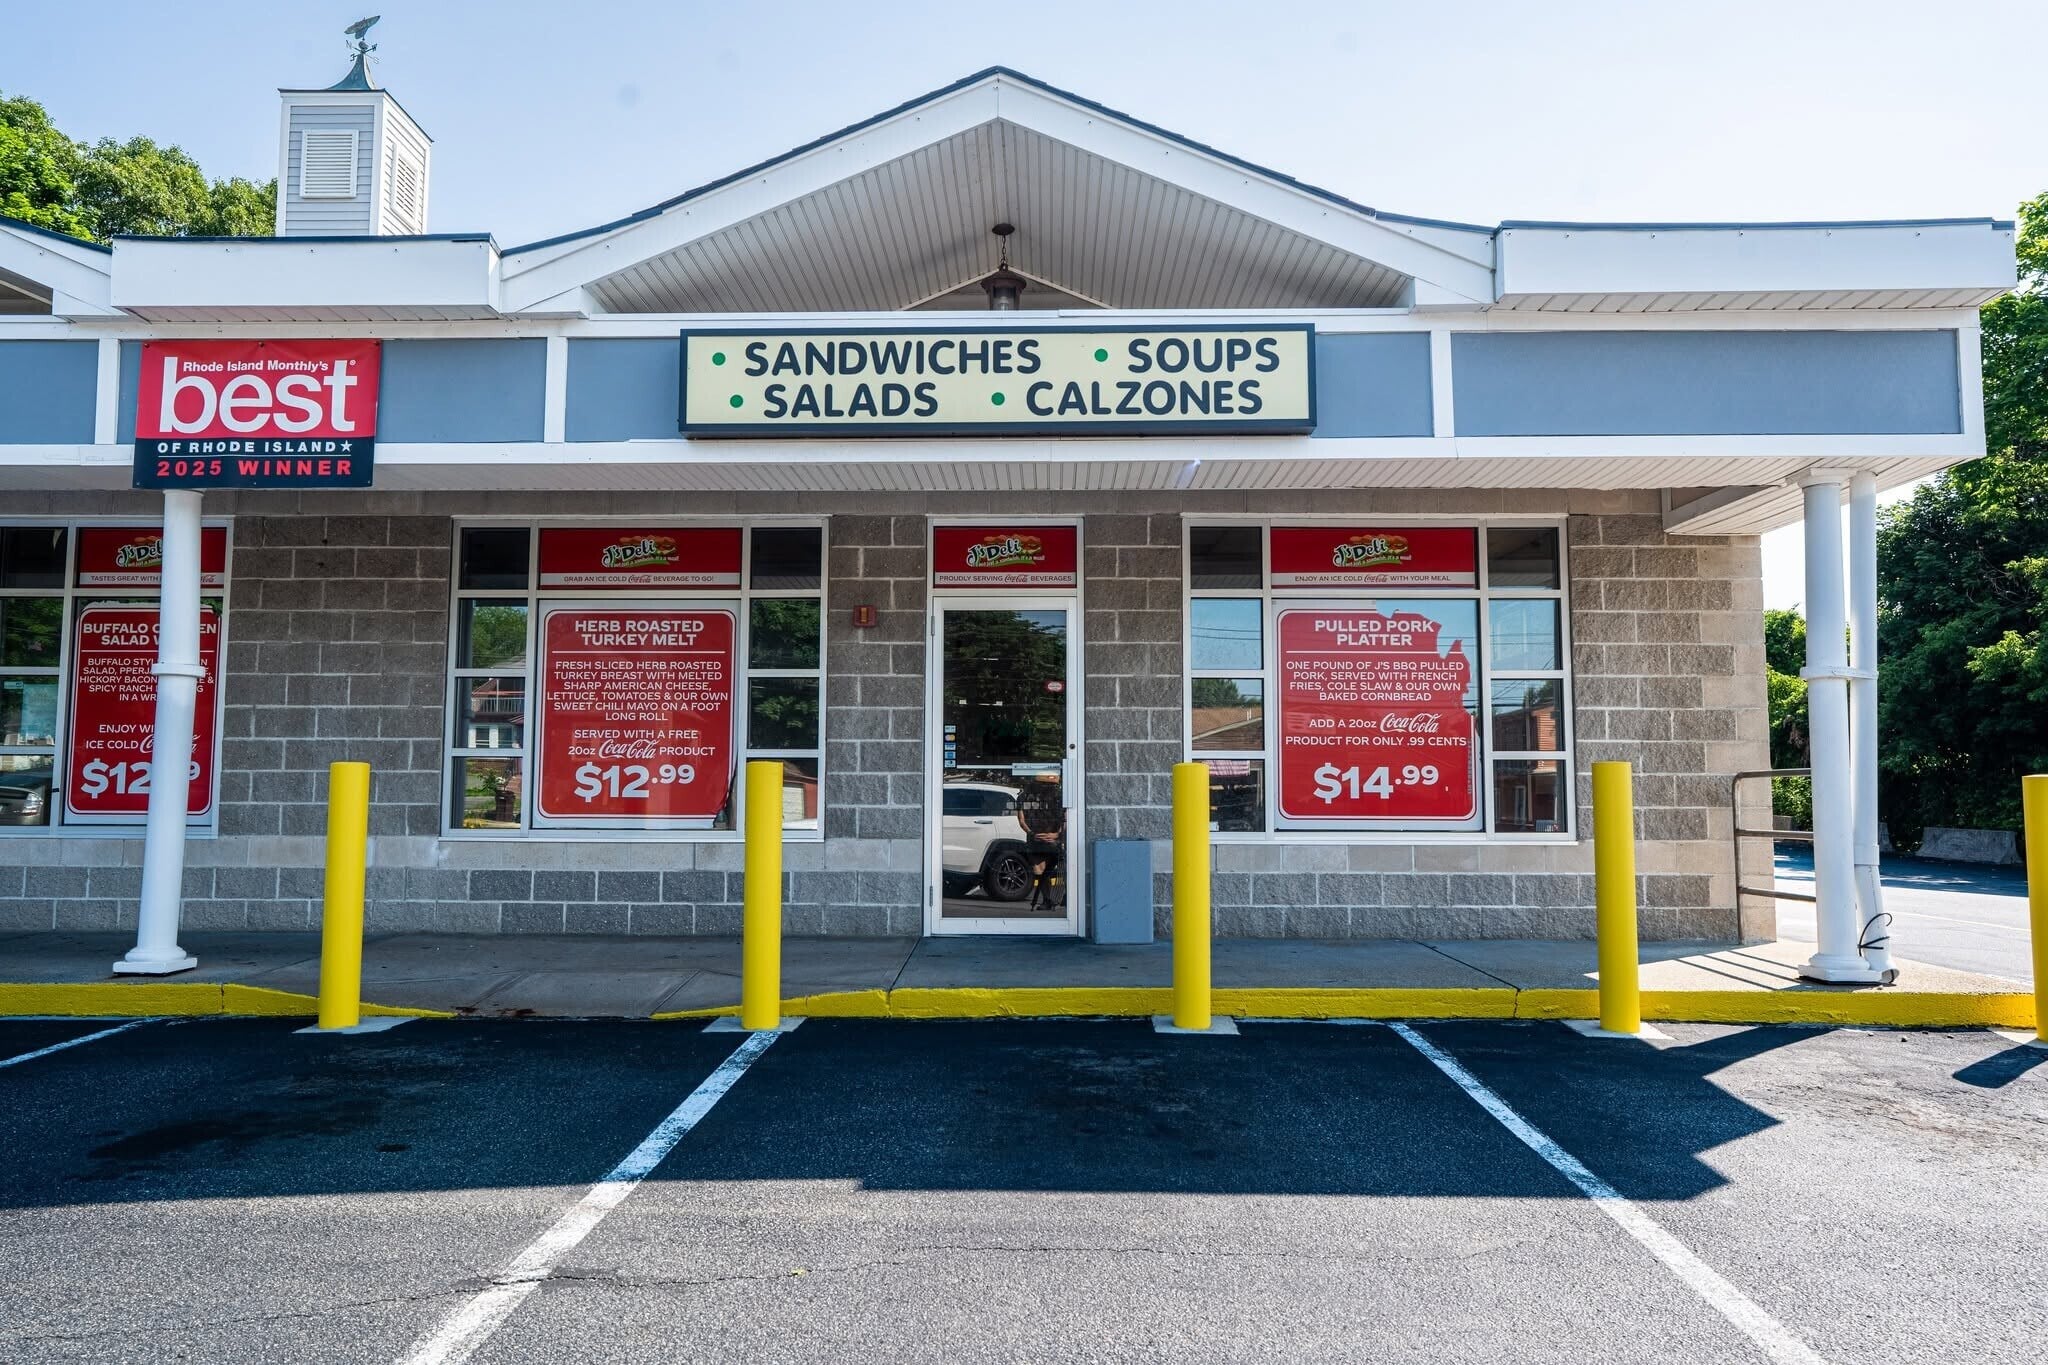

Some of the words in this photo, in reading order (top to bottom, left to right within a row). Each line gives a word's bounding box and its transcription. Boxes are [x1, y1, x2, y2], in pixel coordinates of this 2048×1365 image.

[744, 339, 1042, 378] SANDWICHES
[1128, 337, 1280, 374] SOUPS
[183, 362, 223, 372] Rhode
[227, 360, 263, 371] Island
[267, 360, 328, 372] Monthly's
[159, 357, 357, 434] best
[763, 382, 938, 418] SALADS
[1026, 380, 1263, 416] CALZONES
[158, 443, 181, 453] OF
[189, 442, 255, 453] RHODE
[265, 441, 337, 453] ISLAND
[157, 461, 222, 476] 2025
[238, 460, 351, 476] WINNER
[136, 539, 163, 561] Del
[622, 539, 657, 563] Deli
[985, 538, 1022, 561] Deli
[1352, 538, 1389, 563] Deli
[83, 623, 149, 633] BUFFALO
[575, 620, 621, 632] HERB
[626, 620, 704, 632] ROASTED
[1315, 620, 1381, 632] PULLED
[1386, 620, 1434, 632] PORK
[101, 635, 149, 645] SALAD
[582, 634, 648, 645] TURKEY
[653, 634, 697, 645] MELT
[1337, 634, 1412, 645] PLATTER
[83, 667, 117, 675] SALAD,
[556, 662, 591, 670] FRESH
[595, 662, 633, 670] SLICED
[637, 662, 667, 670] HERB
[670, 662, 721, 670] ROASTED
[1287, 662, 1311, 670] ONE
[1313, 662, 1353, 670] POUND
[1356, 662, 1371, 670] OF
[1374, 662, 1390, 670] J'S
[1393, 662, 1417, 671] BBQ
[1420, 662, 1464, 670] PULLED
[555, 672, 598, 680] TURKEY
[601, 672, 645, 680] BREAST
[646, 672, 675, 680] WITH
[678, 672, 722, 680] MELTED
[1294, 672, 1327, 681] PORK,
[1331, 672, 1375, 680] SERVED
[1378, 672, 1408, 680] WITH
[1412, 672, 1457, 681] FRENCH
[564, 682, 602, 690] SHARP
[605, 682, 662, 690] AMERICAN
[666, 682, 711, 691] CHEESE,
[1290, 682, 1324, 691] FRIES,
[1327, 682, 1356, 690] COLE
[1360, 682, 1393, 690] SLAW
[1395, 682, 1403, 690] &
[1406, 682, 1428, 691] OUR
[1432, 682, 1461, 691] OWN
[547, 692, 598, 701] LETTUCE,
[602, 692, 660, 700] TOMATOES
[664, 692, 671, 700] &
[674, 692, 697, 700] OUR
[700, 692, 728, 700] OWN
[554, 702, 592, 710] SWEET
[595, 702, 624, 710] CHILI
[627, 702, 658, 710] MAYO
[661, 702, 678, 710] ON
[681, 702, 688, 710] A
[691, 702, 720, 710] FOOT
[606, 713, 636, 721] LONG
[639, 713, 668, 721] ROLL
[1309, 719, 1334, 728] ADD
[1337, 719, 1346, 728] A
[1349, 720, 1377, 728] 20oz
[1380, 712, 1442, 733] Coca-Cola
[99, 725, 136, 733] ENJOY
[574, 730, 620, 739] SERVED
[624, 730, 654, 739] WITH
[657, 730, 666, 739] A
[669, 730, 698, 739] FREE
[86, 741, 104, 749] ICE
[107, 741, 139, 749] COLD
[1286, 737, 1342, 745] PRODUCT
[1346, 737, 1369, 745] FOR
[1372, 737, 1404, 745] ONLY
[1407, 737, 1424, 745] .99
[1428, 737, 1467, 746] CENTS
[568, 747, 595, 755] 20oz
[599, 739, 660, 759] Coca-Cola
[660, 747, 715, 755] PRODUCT
[574, 762, 695, 802] $12.99
[1313, 763, 1439, 804] $14.99
